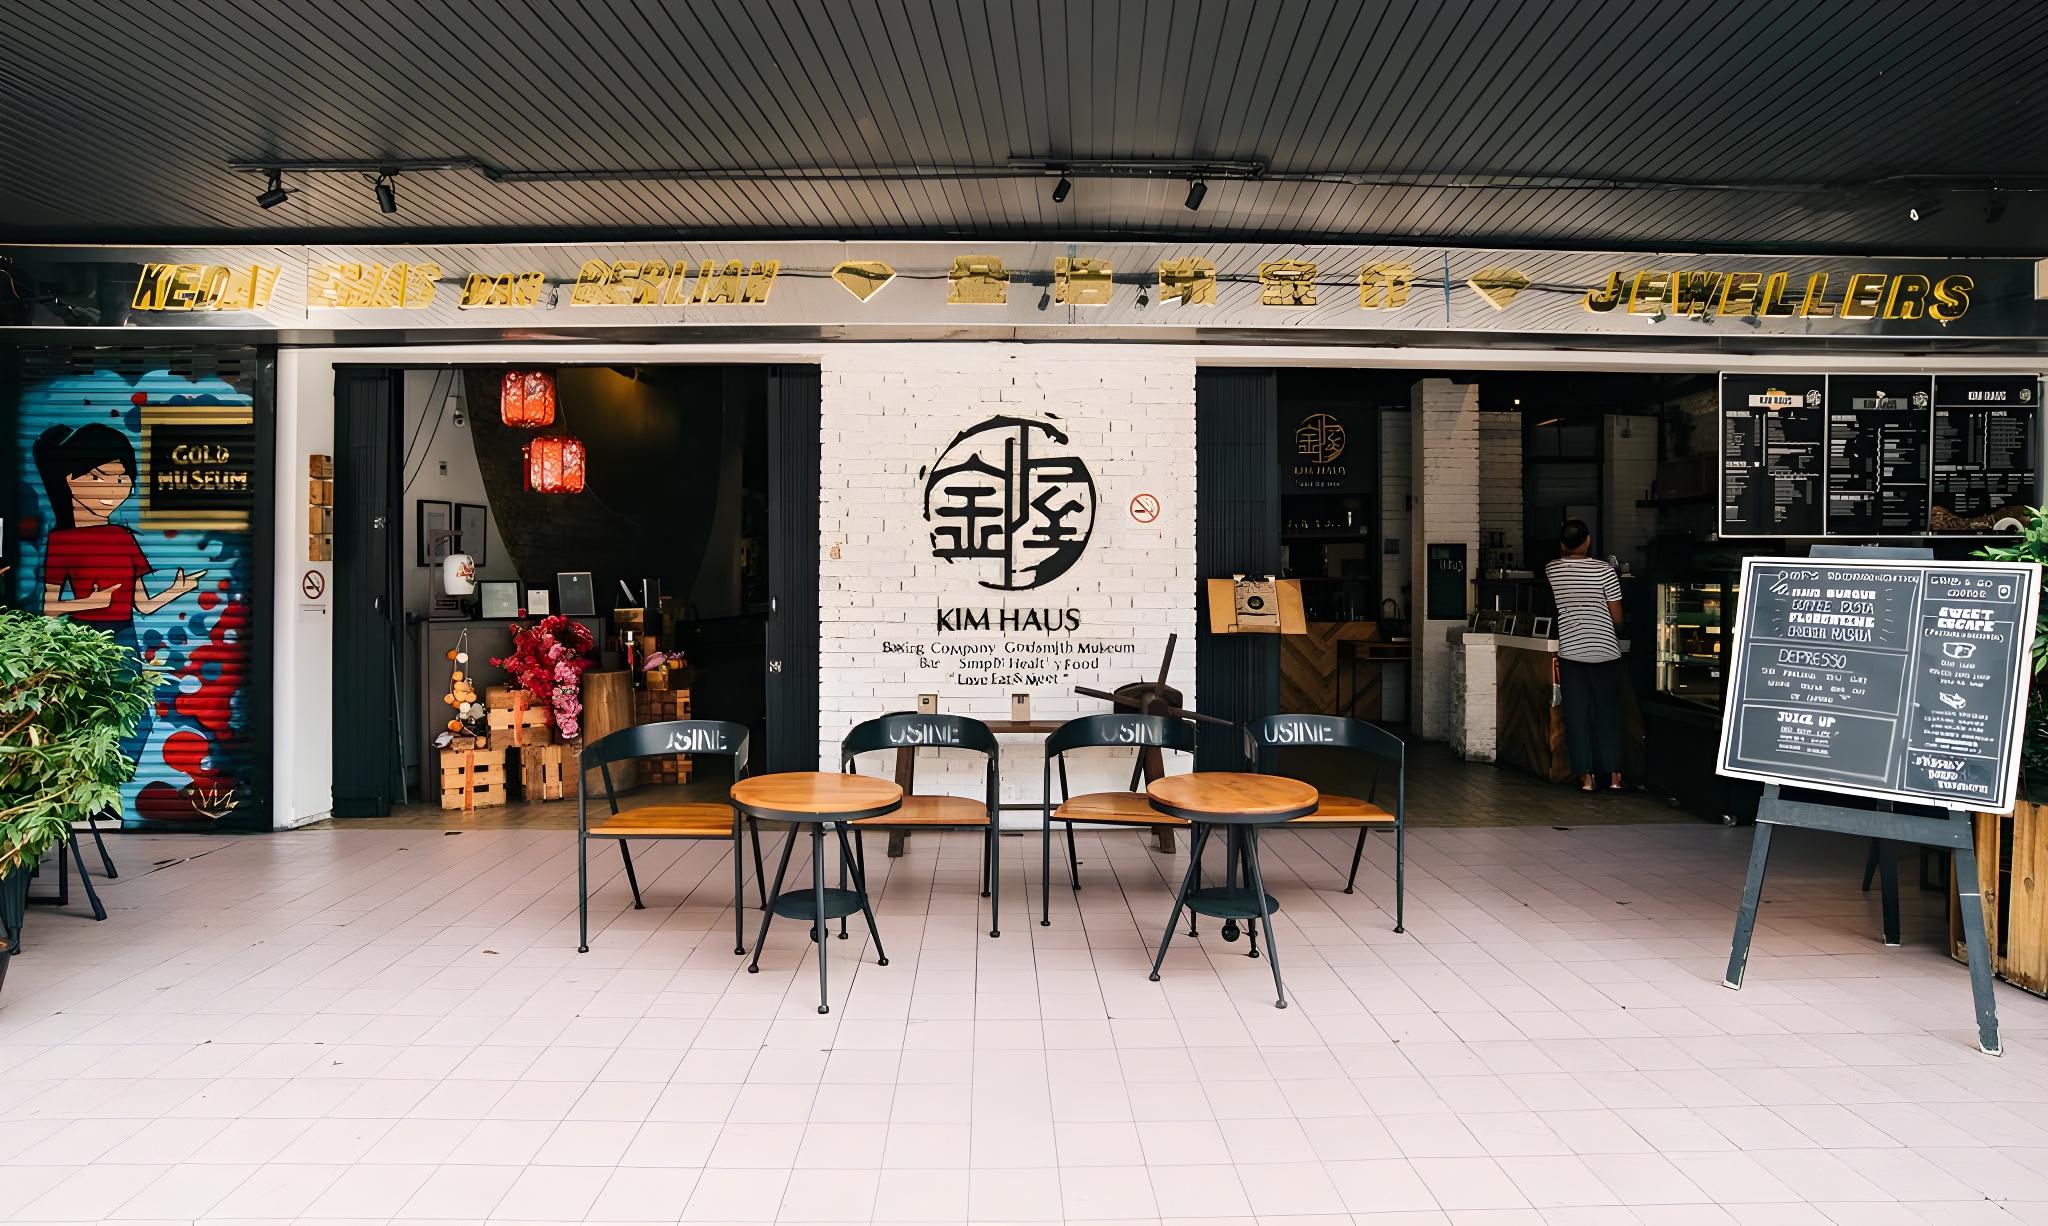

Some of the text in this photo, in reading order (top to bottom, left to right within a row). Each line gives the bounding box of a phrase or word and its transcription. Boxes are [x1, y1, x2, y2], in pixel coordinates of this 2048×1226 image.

[1583, 270, 1975, 320] JEWELLERS
[172, 444, 229, 464] GOLD
[157, 470, 248, 490] MUSEUM
[936, 608, 1081, 632] KIM HAUS
[931, 642, 996, 656] Company
[889, 723, 960, 743] USINE
[1101, 723, 1163, 743] USIN
[1264, 722, 1334, 742] USINE
